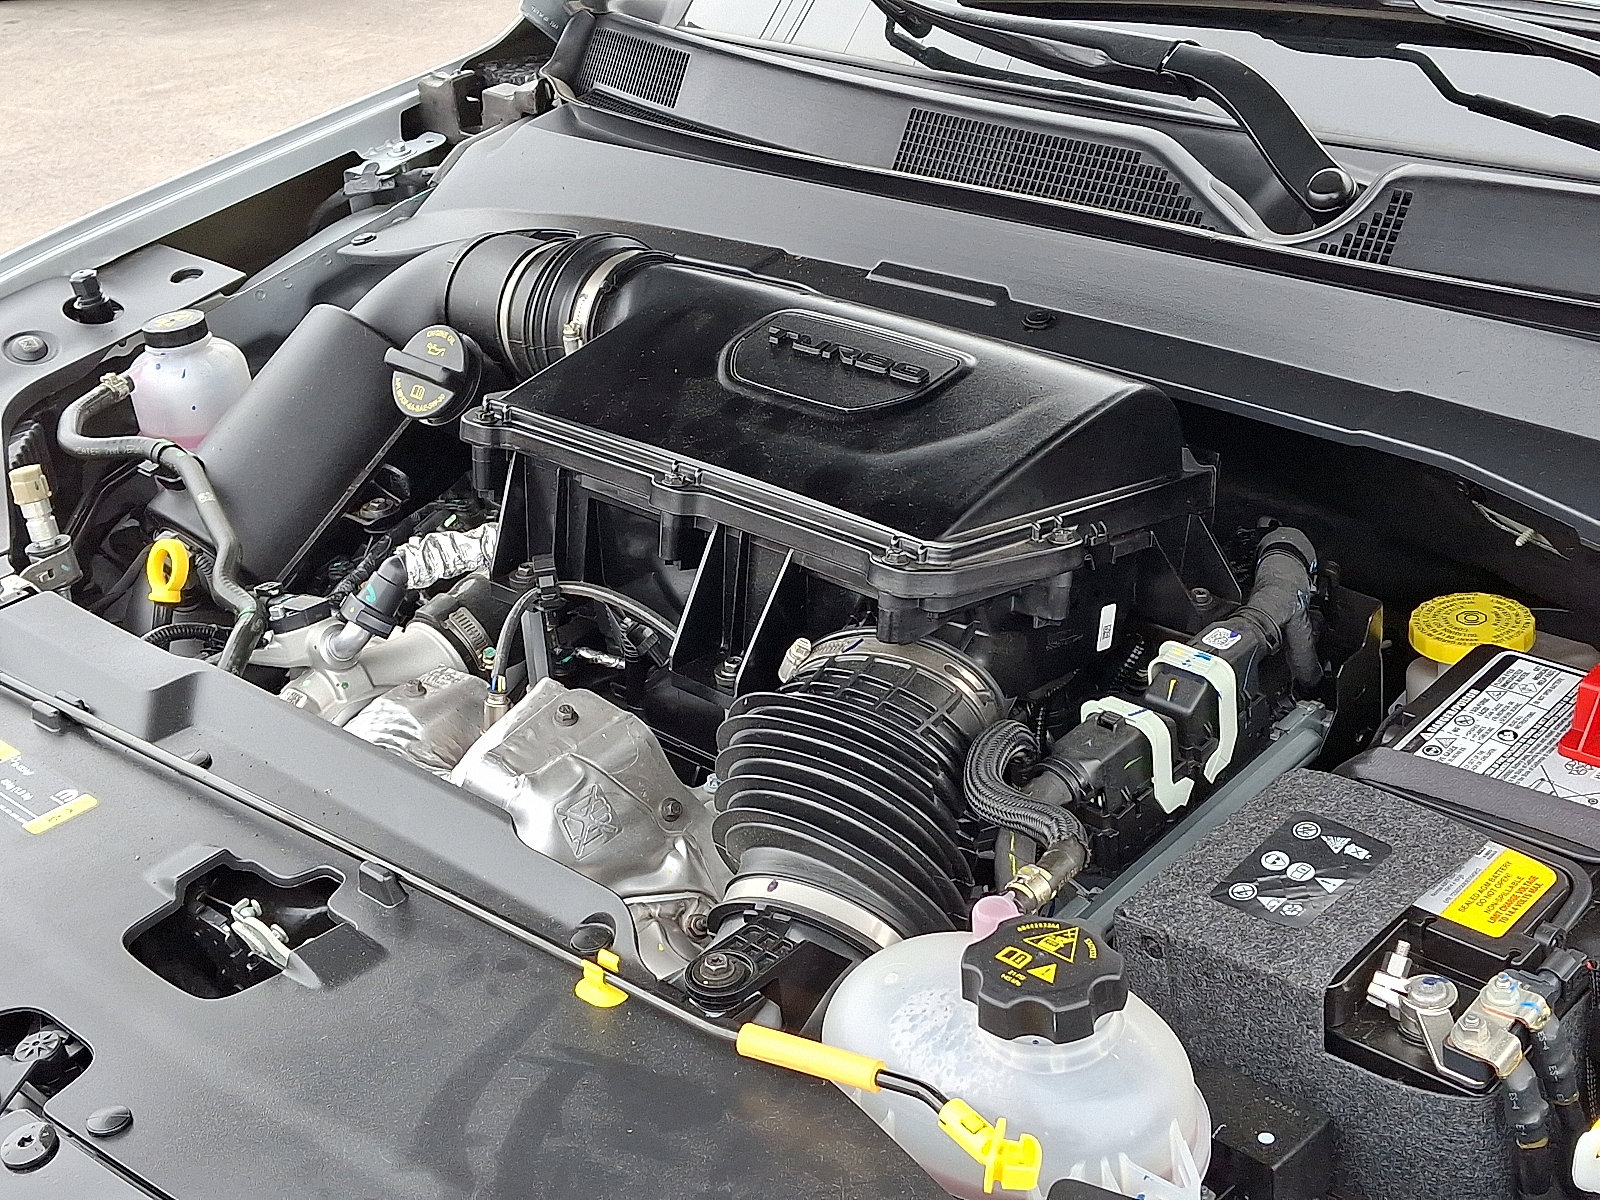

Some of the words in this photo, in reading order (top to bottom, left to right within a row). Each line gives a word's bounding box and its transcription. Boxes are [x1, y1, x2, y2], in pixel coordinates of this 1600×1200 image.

[768, 325, 930, 384] TURBO
[1458, 891, 1480, 912] SEALED
[1488, 861, 1512, 884] BATTERY
[1476, 898, 1487, 908] DO
[1485, 889, 1496, 901] NOT
[1501, 893, 1519, 912] CHARGE
[1515, 875, 1539, 896] VOLTAGE
[1498, 915, 1510, 924] TO
[1516, 893, 1533, 911] VOLTS
